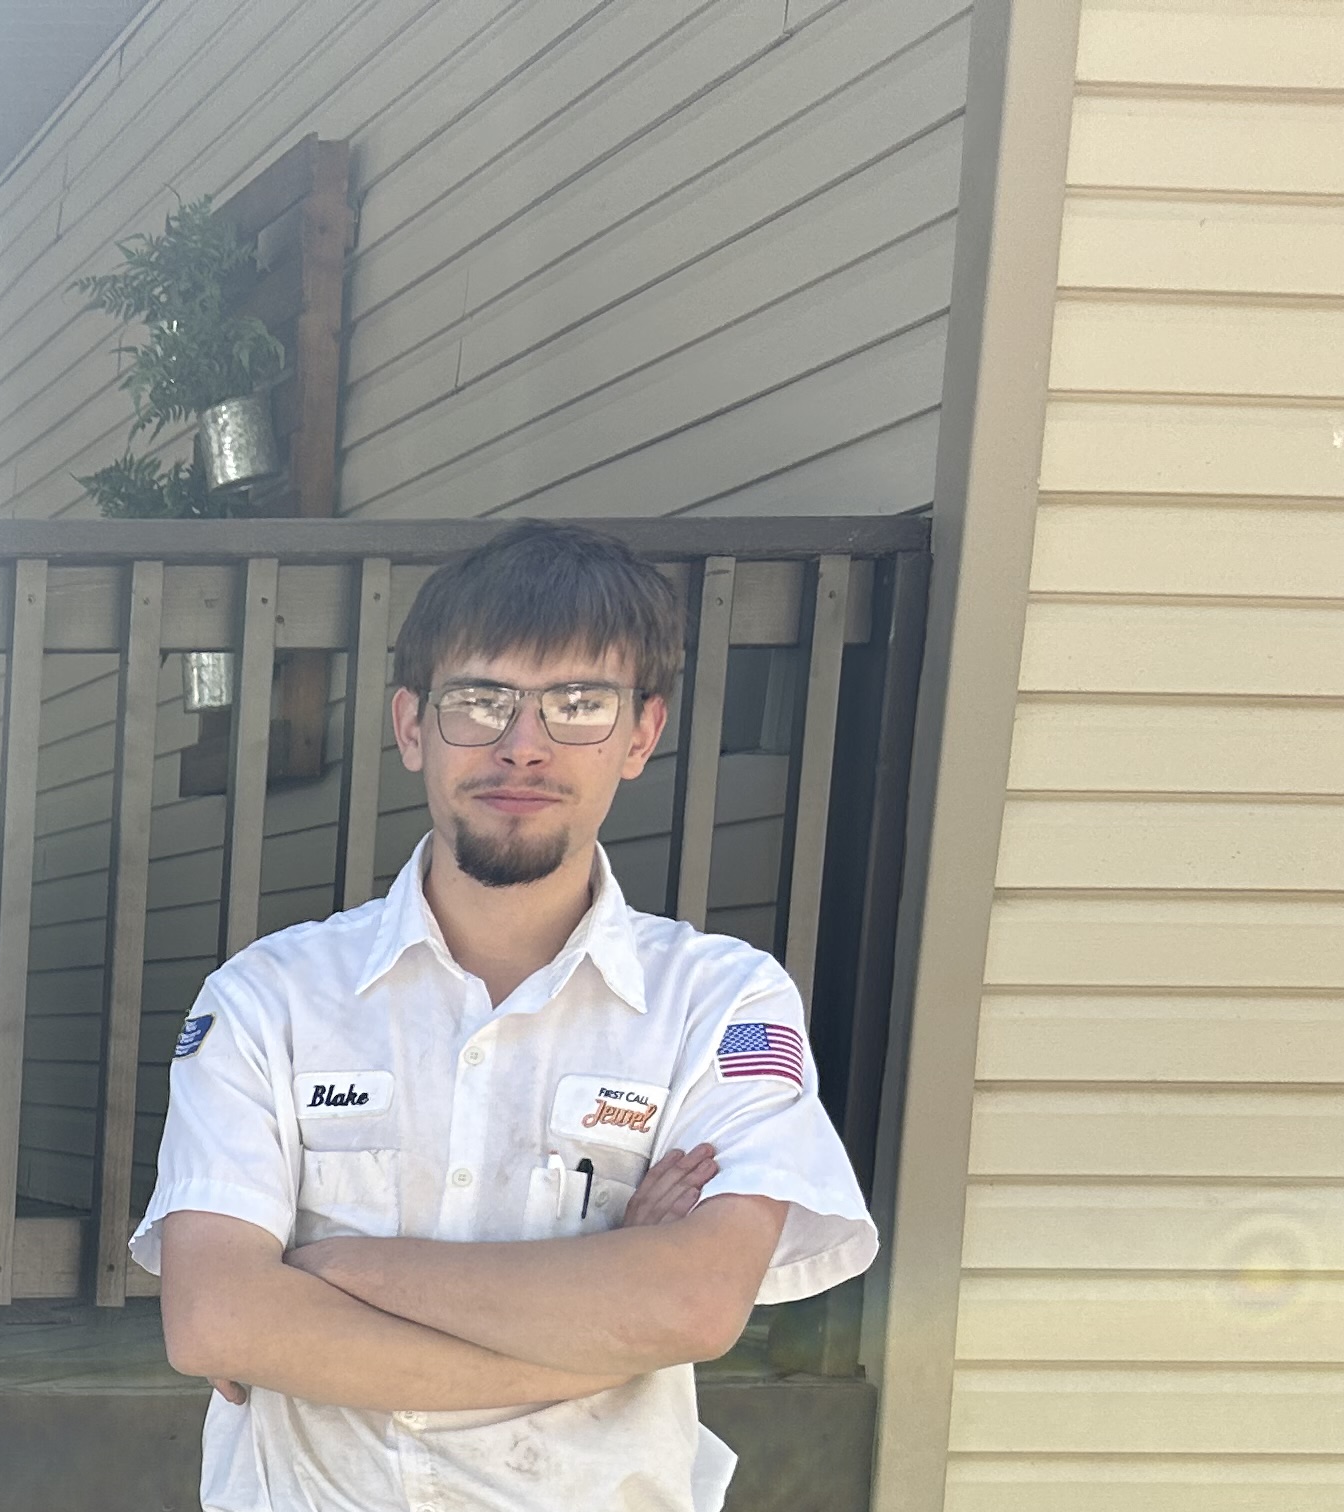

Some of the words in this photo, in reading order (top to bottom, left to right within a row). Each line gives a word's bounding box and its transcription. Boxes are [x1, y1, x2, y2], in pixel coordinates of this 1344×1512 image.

[306, 1083, 370, 1108] Blake
[598, 1087, 625, 1101] FIRST
[626, 1091, 650, 1106] CALL
[581, 1098, 659, 1134] Jewel
